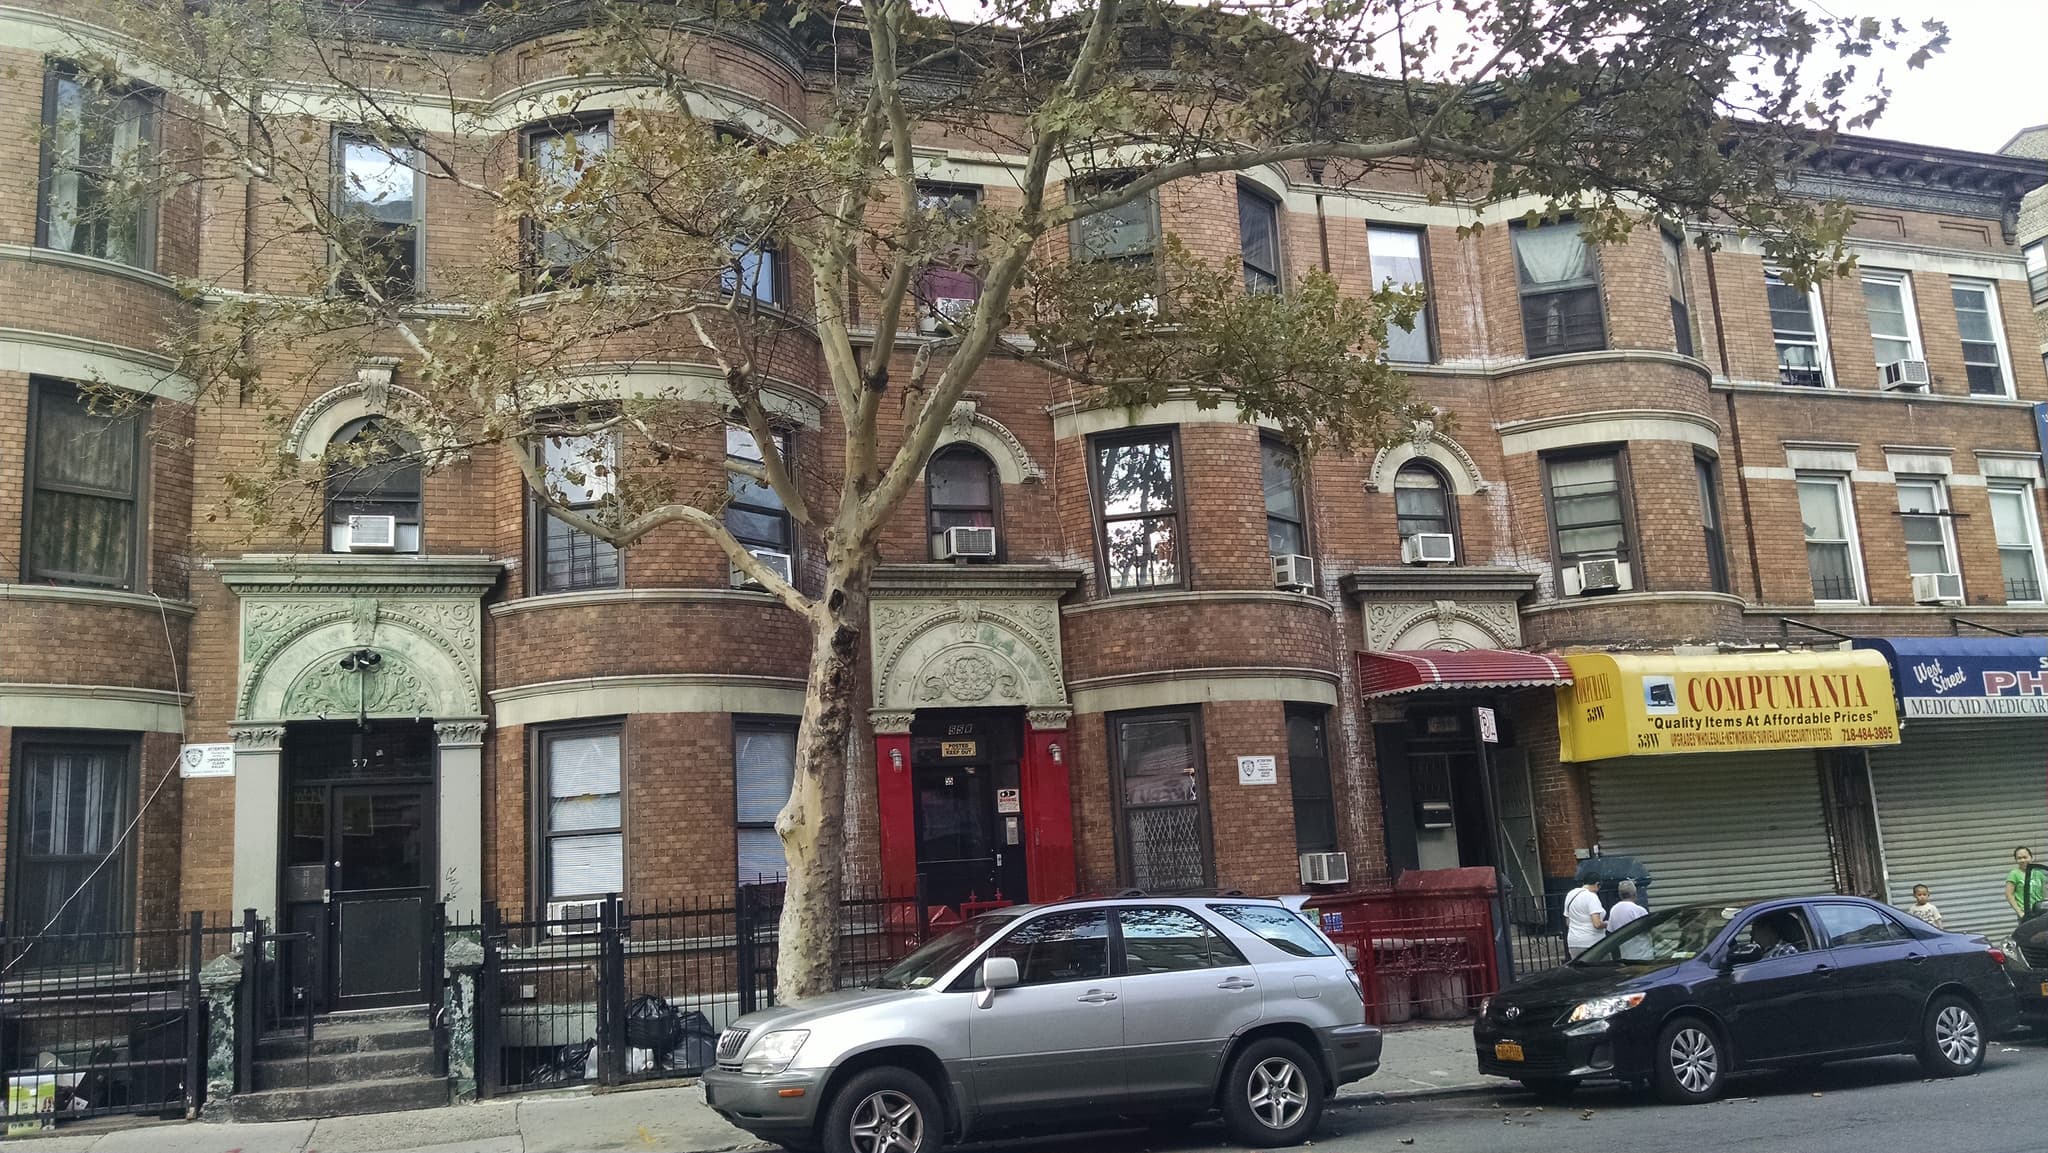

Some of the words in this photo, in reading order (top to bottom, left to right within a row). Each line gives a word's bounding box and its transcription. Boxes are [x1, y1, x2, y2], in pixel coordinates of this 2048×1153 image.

[1913, 657, 1943, 684] West
[1931, 666, 1967, 694] Street
[1688, 674, 1870, 713] COMPUMANIA
[1705, 716, 1743, 728] Items
[1745, 714, 1760, 727] At
[1763, 712, 1831, 726] Affordable
[1637, 733, 1660, 749] 53W
[1841, 726, 1893, 743] 718-484-3895
[352, 758, 368, 767] 57
